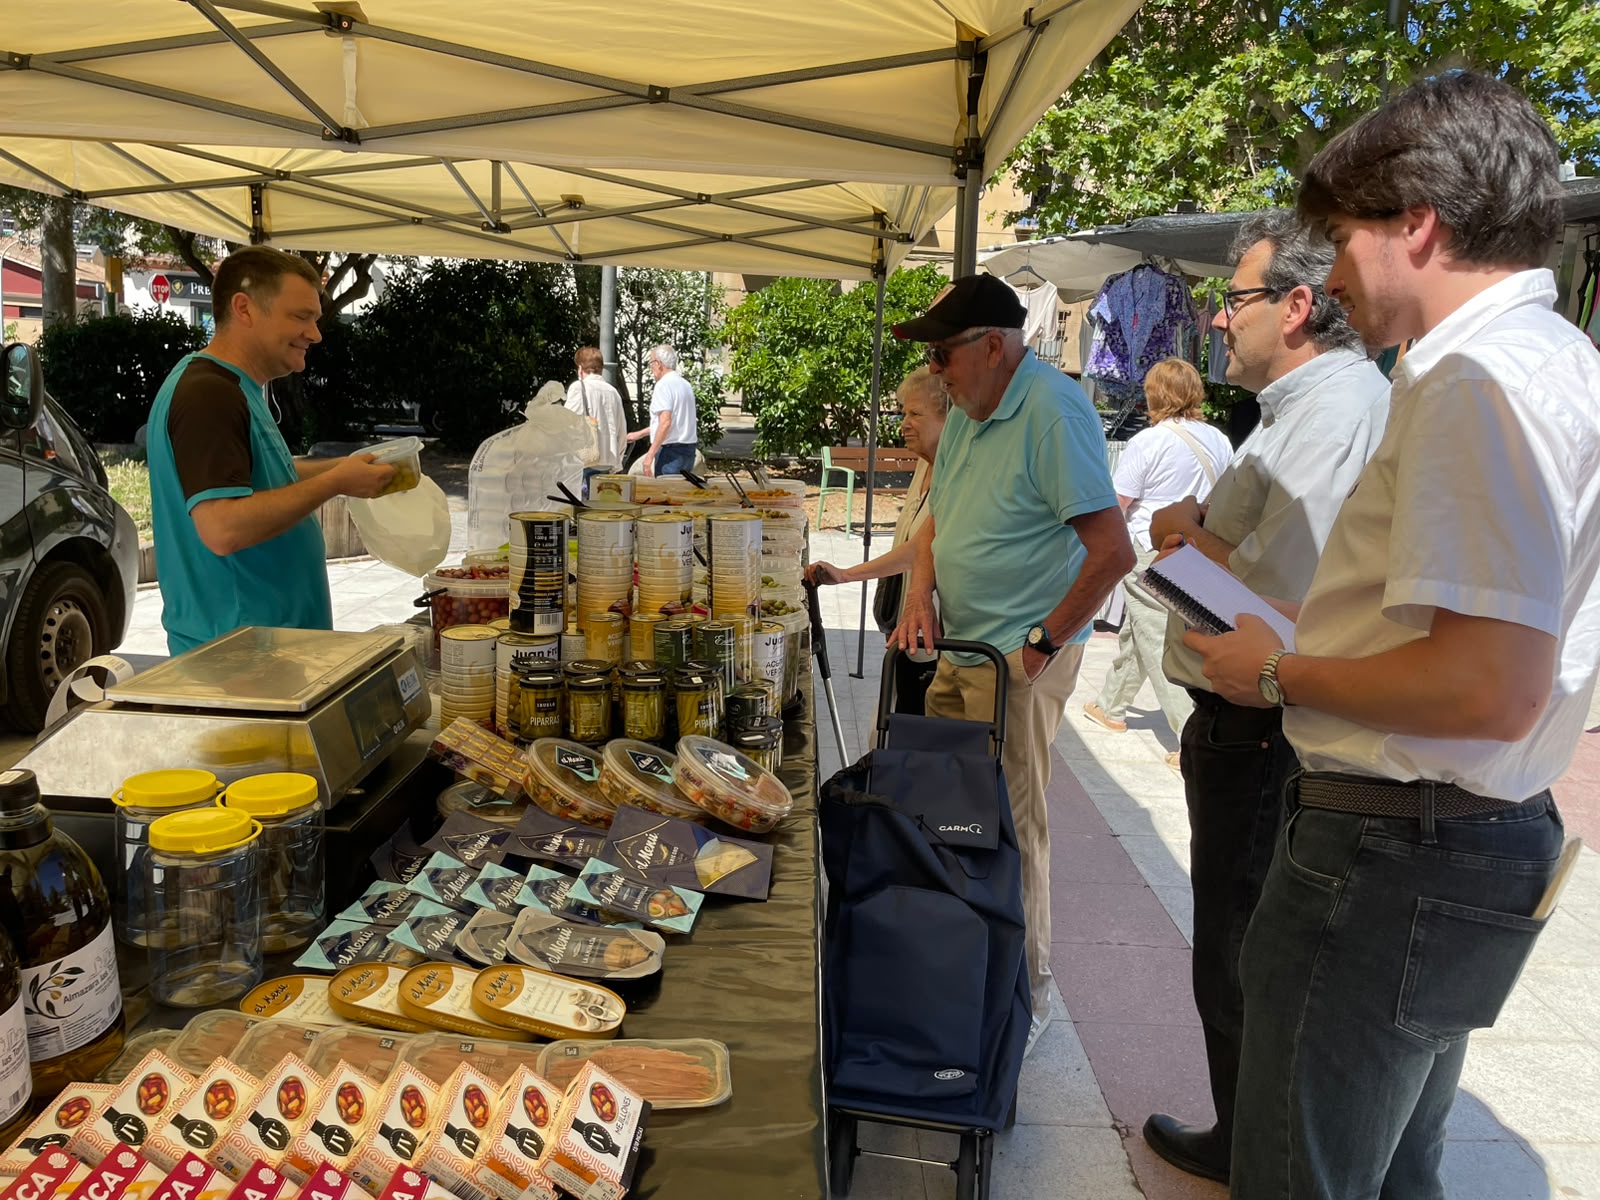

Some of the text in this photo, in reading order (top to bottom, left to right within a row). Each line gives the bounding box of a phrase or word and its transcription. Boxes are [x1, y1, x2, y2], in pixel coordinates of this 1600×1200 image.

[153, 285, 169, 293] STOP
[530, 715, 560, 727] PIPARRAS
[638, 833, 659, 864] Menú
[635, 860, 649, 869] el
[443, 870, 471, 901] el Menú
[501, 879, 523, 904] Menú
[551, 880, 571, 907] Menú
[603, 874, 625, 900] Menú
[383, 890, 411, 917] Menú
[339, 930, 376, 965] el Menú
[426, 917, 460, 951] el Menú
[546, 928, 574, 964] el Menú
[63, 980, 100, 1004] Almazara
[614, 1096, 632, 1135] MEJILLONES
